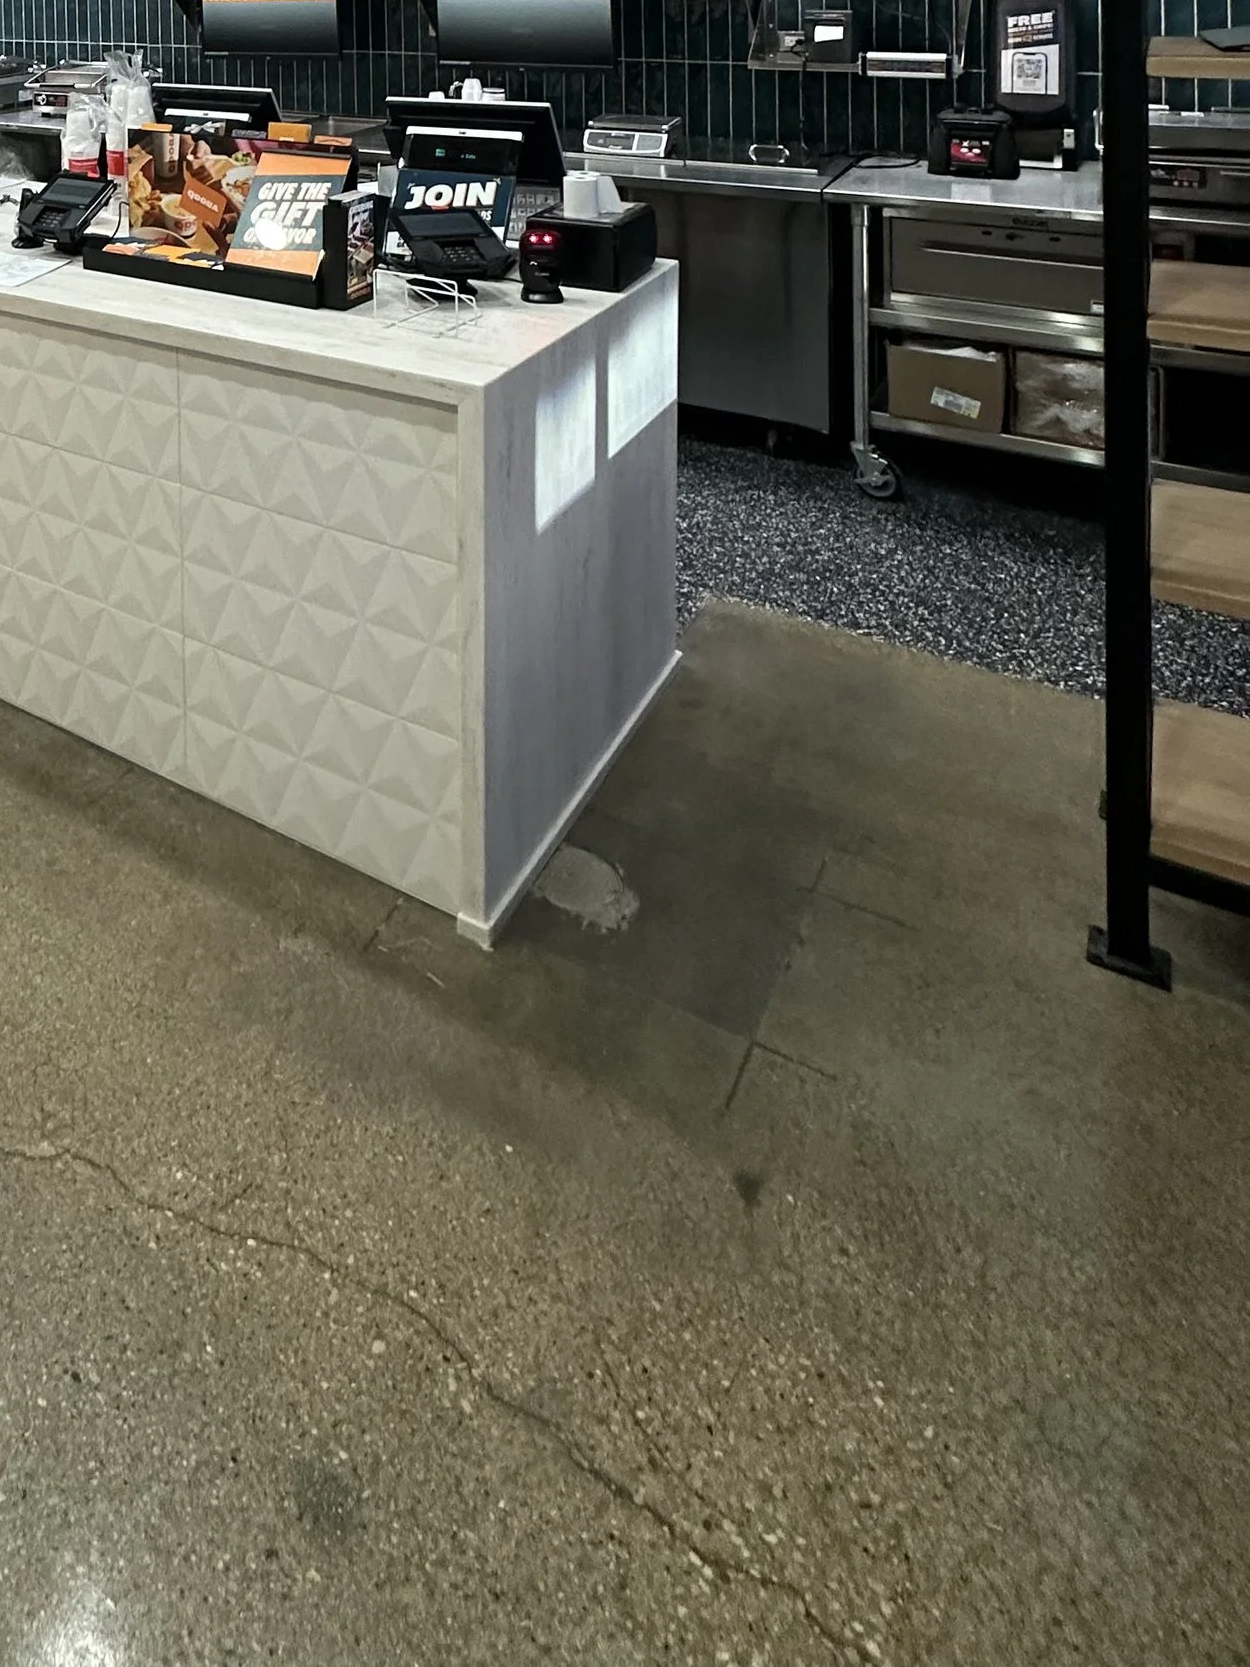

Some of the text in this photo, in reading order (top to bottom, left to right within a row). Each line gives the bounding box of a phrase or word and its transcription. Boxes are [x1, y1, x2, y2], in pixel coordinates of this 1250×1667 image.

[1007, 12, 1054, 28] FREE
[257, 182, 332, 201] GIVE THE
[404, 181, 498, 210] JOIN
[250, 201, 326, 227] GIFT
